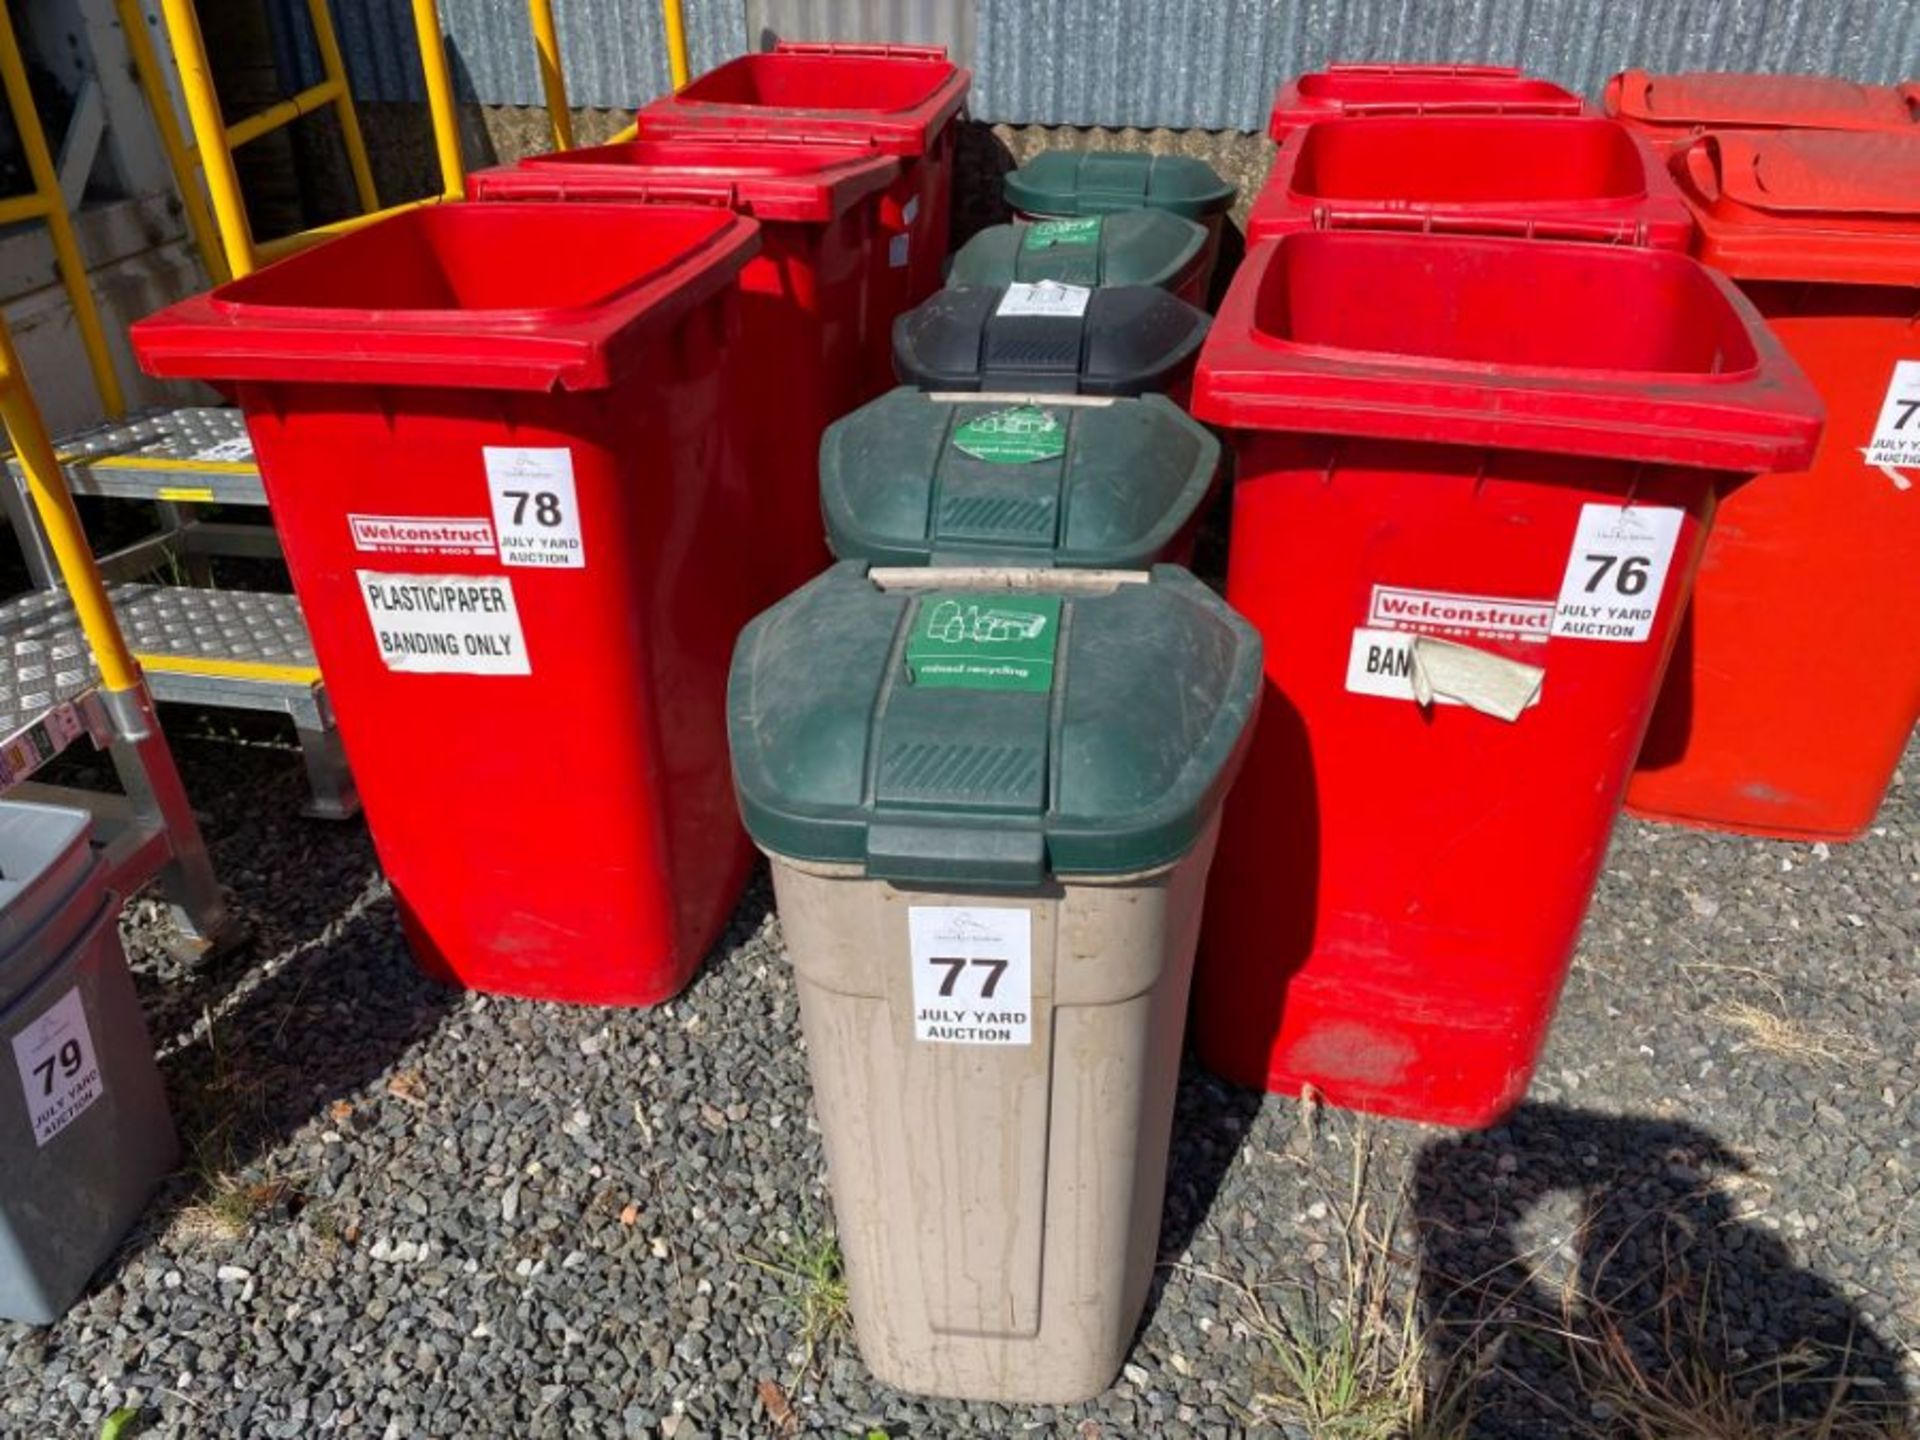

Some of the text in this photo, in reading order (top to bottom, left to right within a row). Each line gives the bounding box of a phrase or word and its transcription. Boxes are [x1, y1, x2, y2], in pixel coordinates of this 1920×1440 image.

[1893, 399, 1920, 430] 7
[1872, 438, 1907, 451] JULY
[502, 490, 563, 528] 78
[359, 524, 490, 543] Welconstruct
[501, 536, 579, 549] JULY YARD
[508, 551, 569, 564] AUCTION
[1584, 554, 1652, 597] 76
[368, 584, 507, 613] PLASTIC/PAPER
[1382, 596, 1548, 628] Welconstruct
[1558, 604, 1652, 620] JULY YARD
[380, 630, 512, 656] BANDING ONLY
[1560, 622, 1635, 637] AUCTION
[929, 957, 1009, 999] 77
[917, 1008, 1027, 1025] JULY YARD
[926, 1025, 1012, 1041] AUCTION
[33, 1038, 82, 1096] 79
[36, 1069, 97, 1128] JULY YARD
[43, 1089, 93, 1137] AUCTION
